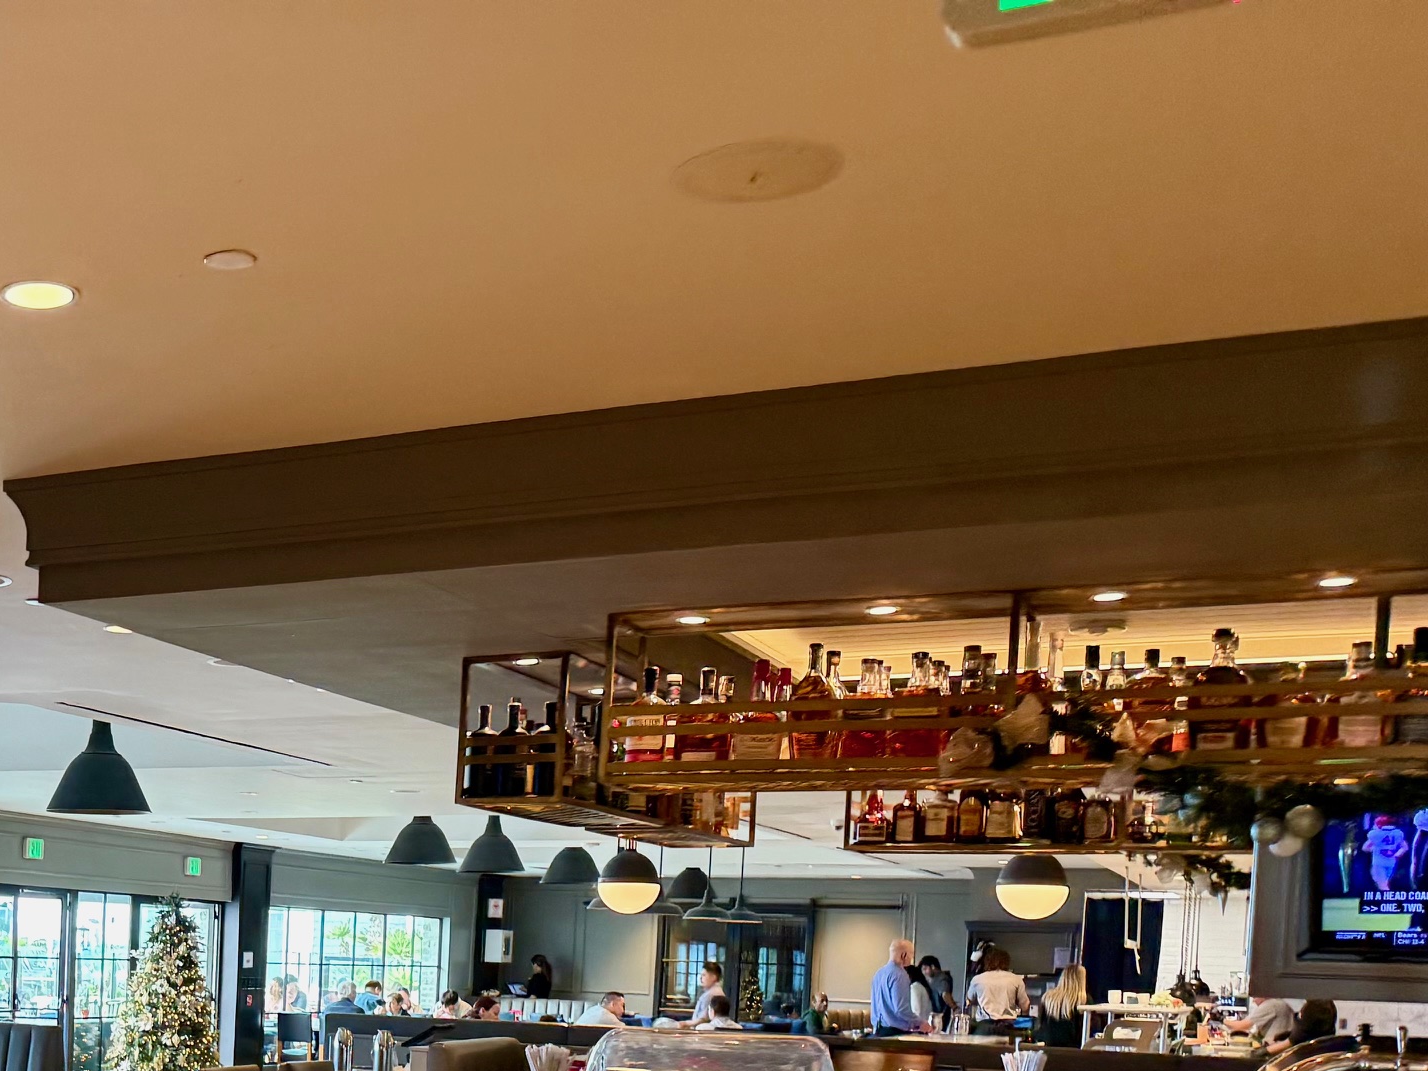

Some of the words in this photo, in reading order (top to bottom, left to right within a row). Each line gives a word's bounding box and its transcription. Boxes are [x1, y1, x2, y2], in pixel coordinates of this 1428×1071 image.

[1364, 891, 1374, 900] IN
[1375, 891, 1382, 900] A
[1383, 891, 1407, 900] HEAD
